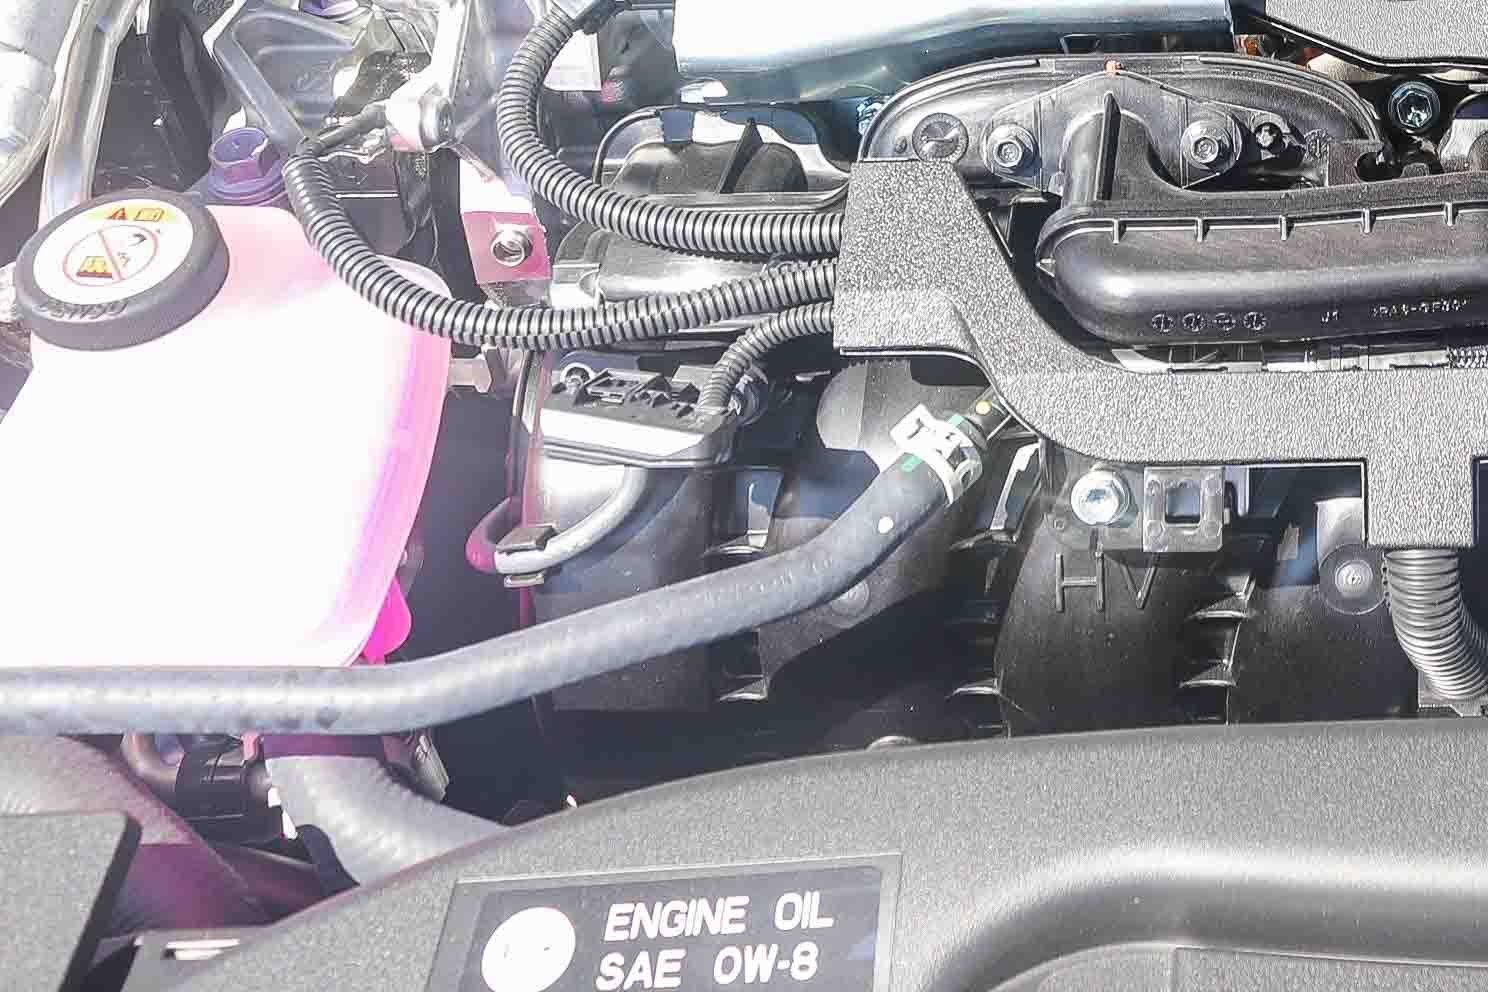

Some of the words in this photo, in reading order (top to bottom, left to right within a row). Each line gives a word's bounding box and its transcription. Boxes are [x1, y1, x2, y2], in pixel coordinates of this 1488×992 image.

[604, 895, 750, 942] ENGINE
[774, 891, 834, 931] OIL
[595, 948, 687, 992] SAE
[713, 941, 819, 985] 0W-8
